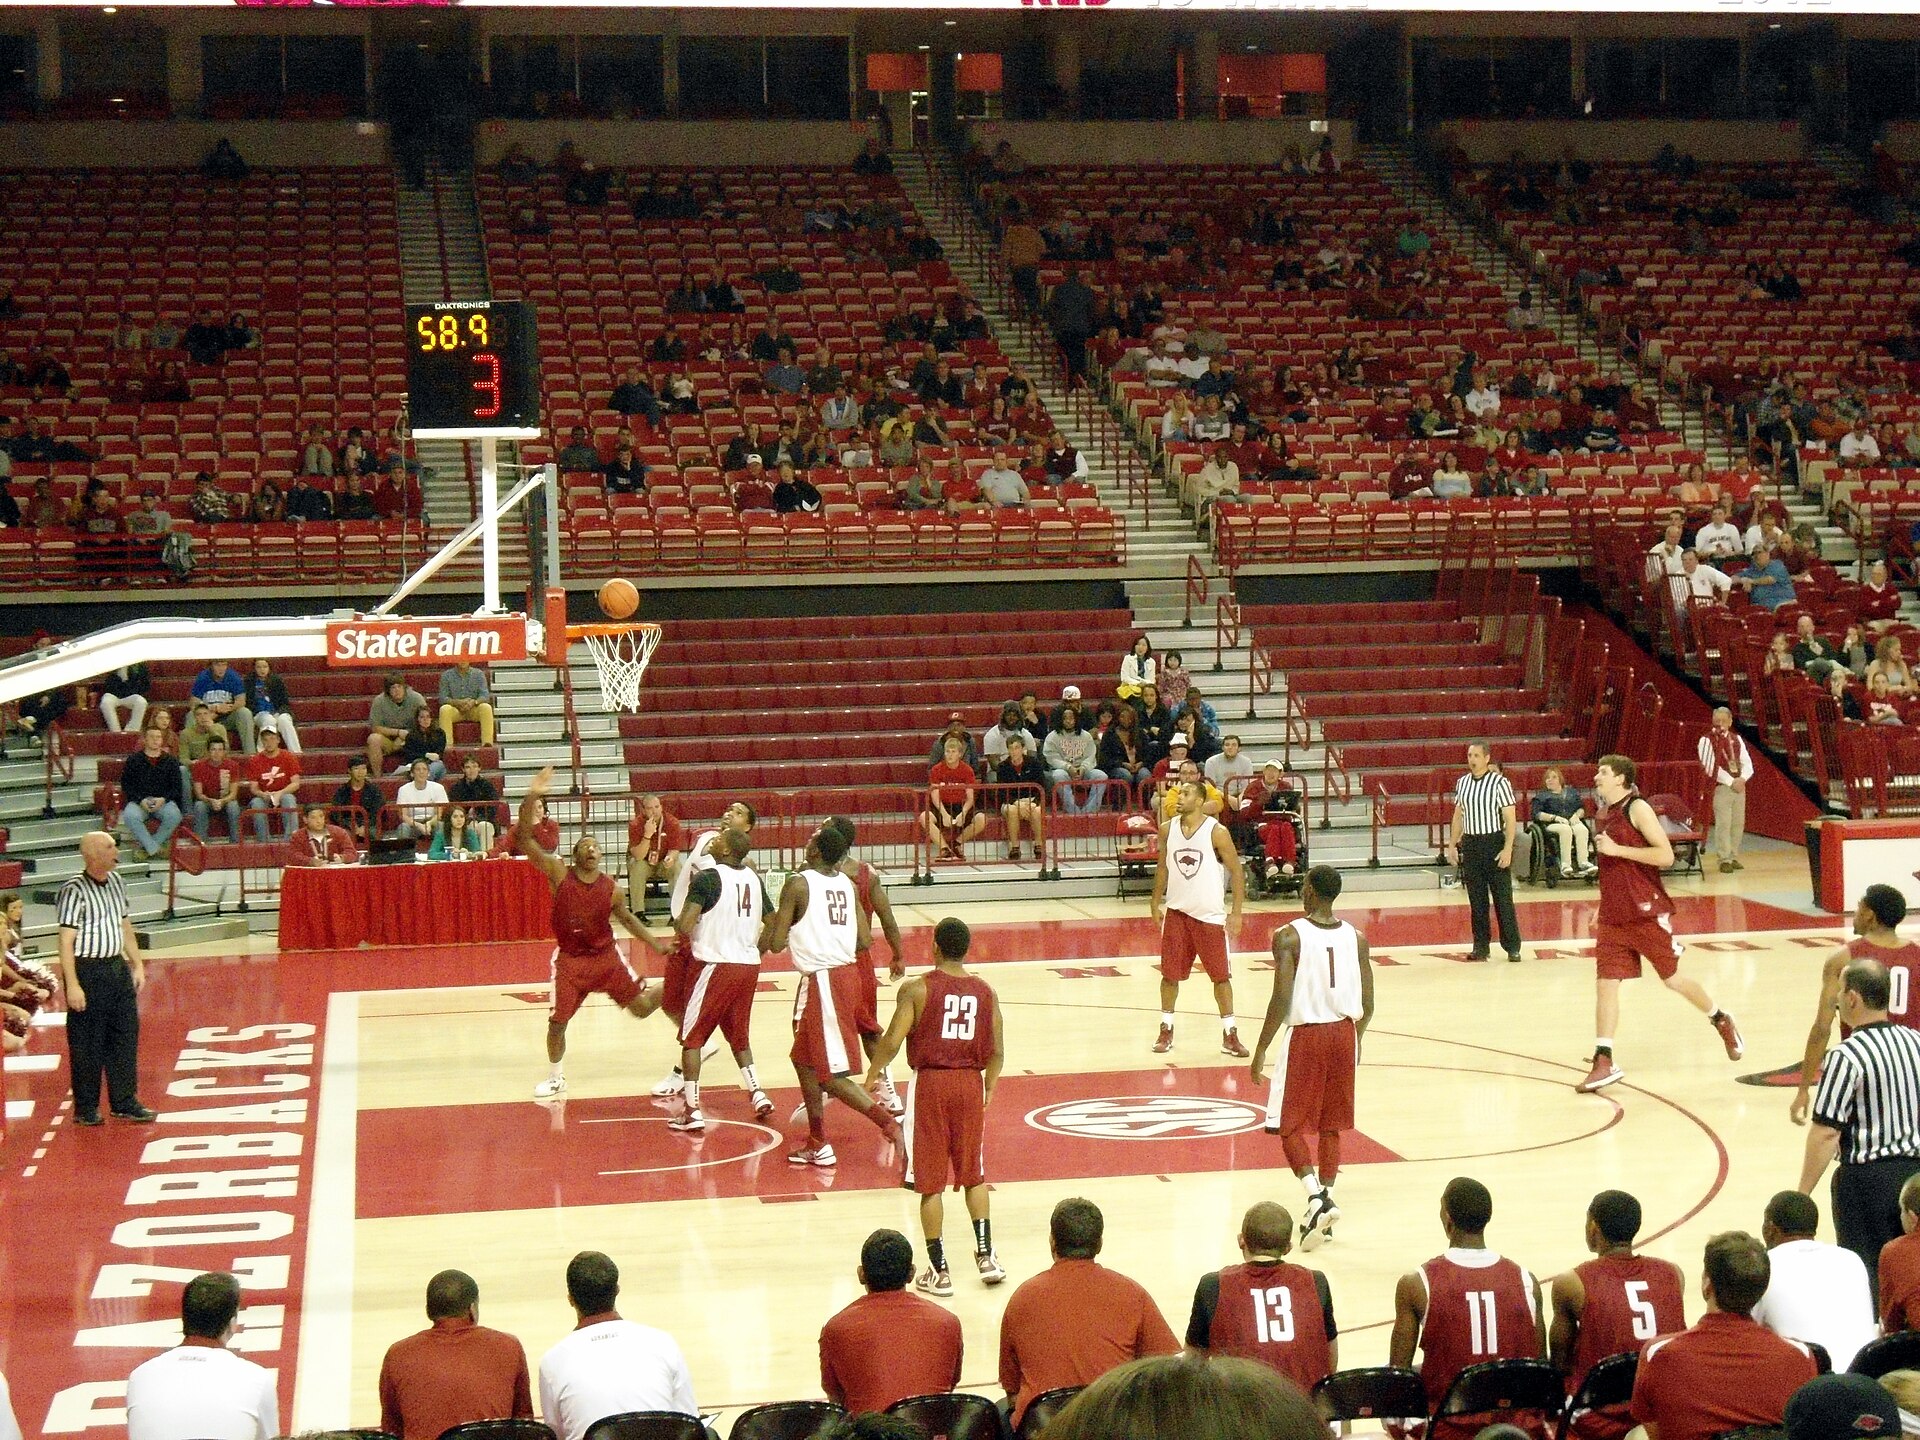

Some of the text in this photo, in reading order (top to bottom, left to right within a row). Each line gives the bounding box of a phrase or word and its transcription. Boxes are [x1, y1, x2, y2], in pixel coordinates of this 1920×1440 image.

[434, 301, 490, 310] DAKTRONICS
[417, 314, 487, 350] 58.9
[472, 354, 499, 417] 3
[335, 627, 500, 660] State Farm
[736, 883, 751, 917] 14
[825, 889, 848, 926] 22
[1326, 946, 1336, 989] 1
[941, 993, 978, 1041] 23
[1250, 1286, 1295, 1343] 13
[1465, 1291, 1498, 1355] 11
[1624, 1281, 1657, 1340] 5
